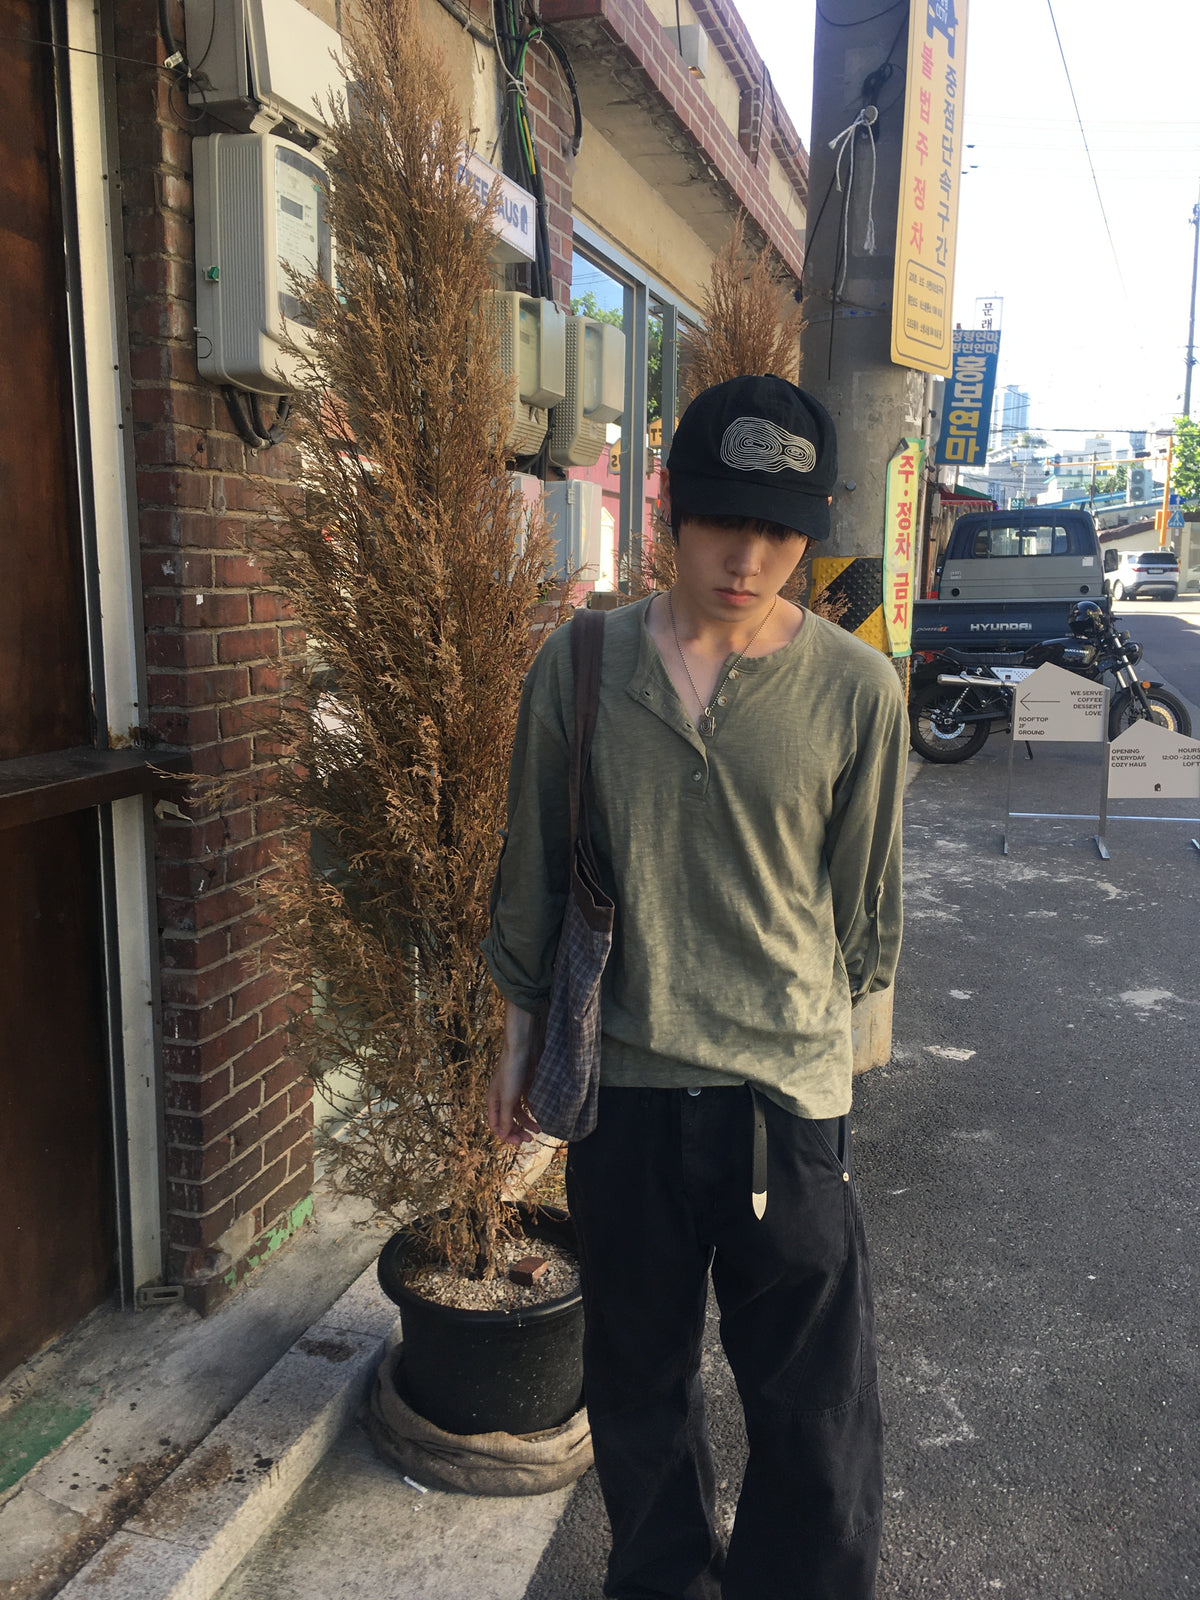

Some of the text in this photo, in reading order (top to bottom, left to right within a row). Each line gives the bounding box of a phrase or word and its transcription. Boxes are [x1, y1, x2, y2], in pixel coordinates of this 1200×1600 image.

[935, 63, 957, 268] 중점단속구간
[892, 572, 910, 630] 금지
[970, 622, 1032, 632] HYUNDAI
